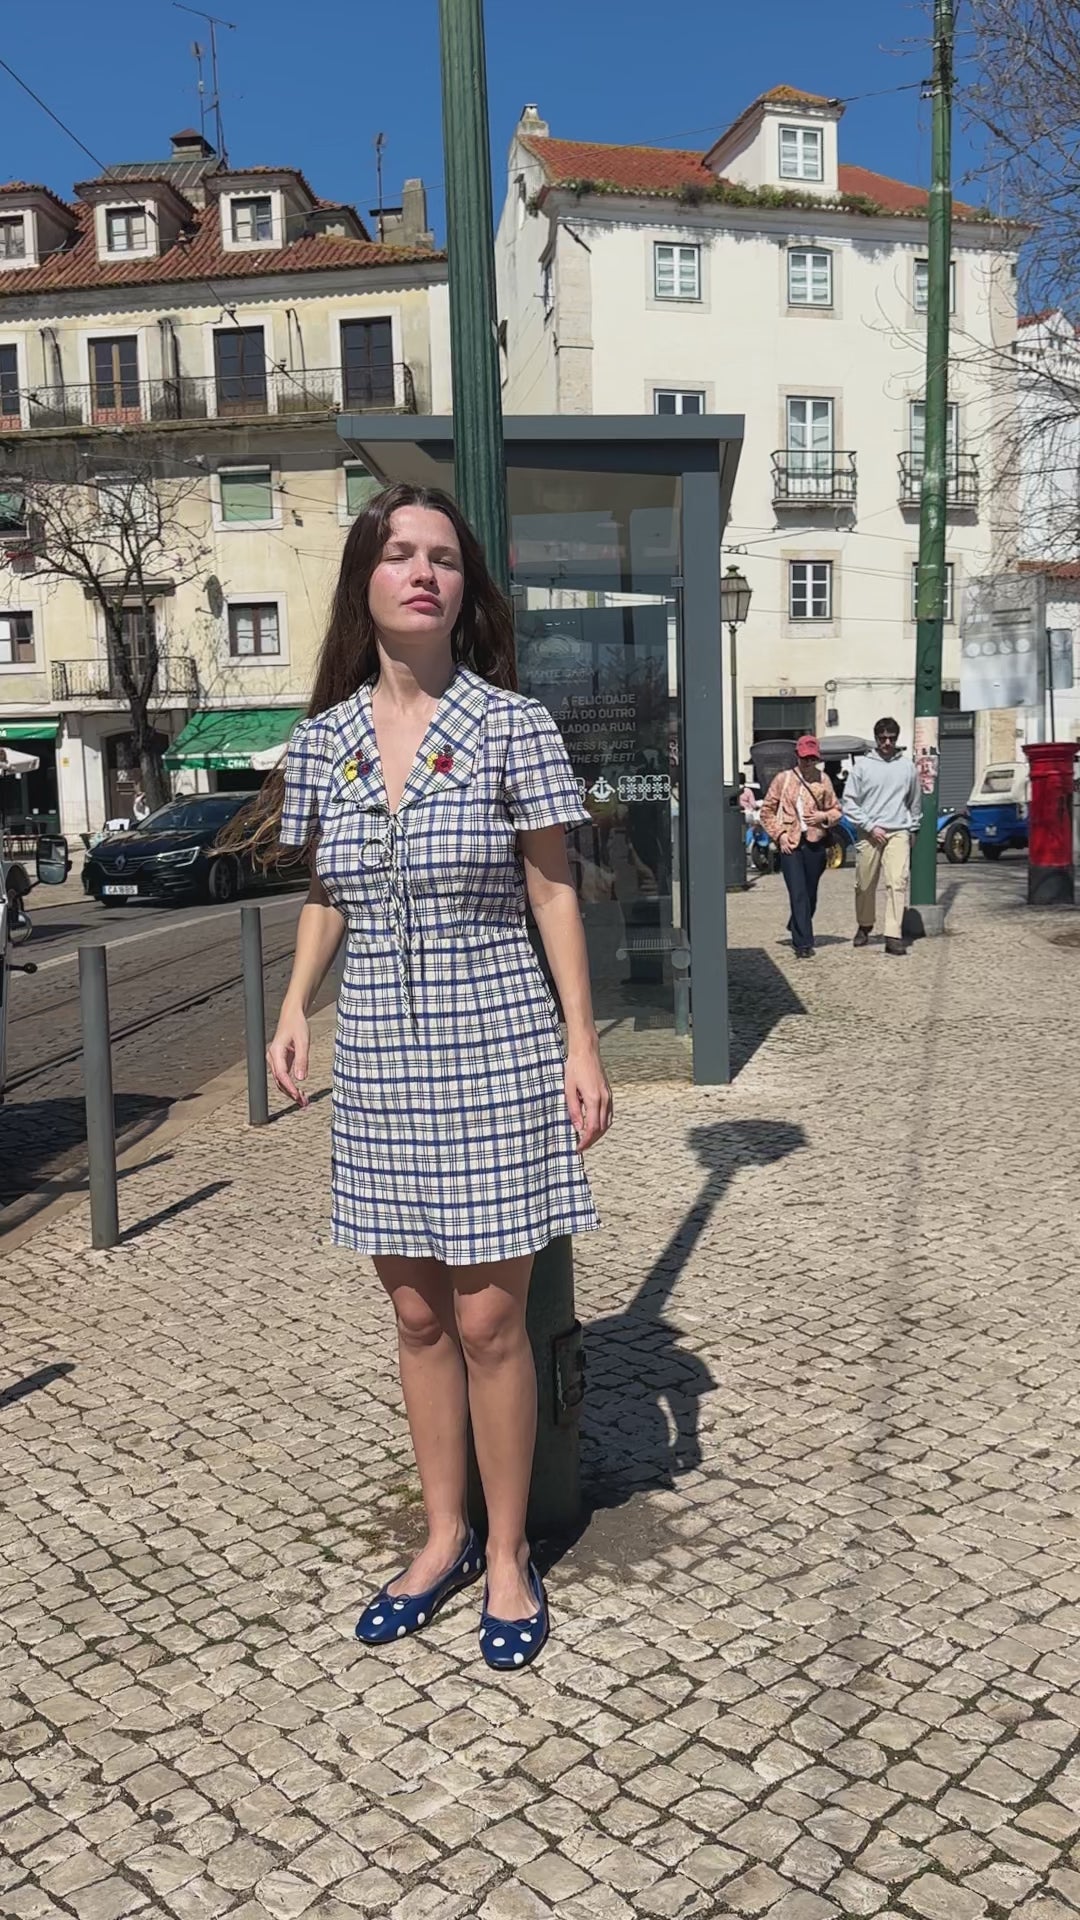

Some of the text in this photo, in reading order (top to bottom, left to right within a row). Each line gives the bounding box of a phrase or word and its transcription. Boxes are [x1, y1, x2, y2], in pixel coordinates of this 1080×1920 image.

[561, 694, 636, 706] A FELICIDADE
[581, 709, 596, 719] DO
[599, 708, 636, 719] OUTRO
[561, 721, 636, 734] LADO DA RUA!
[598, 740, 608, 751] IS
[609, 739, 636, 750] JUST
[571, 753, 635, 763] THE STREET!
